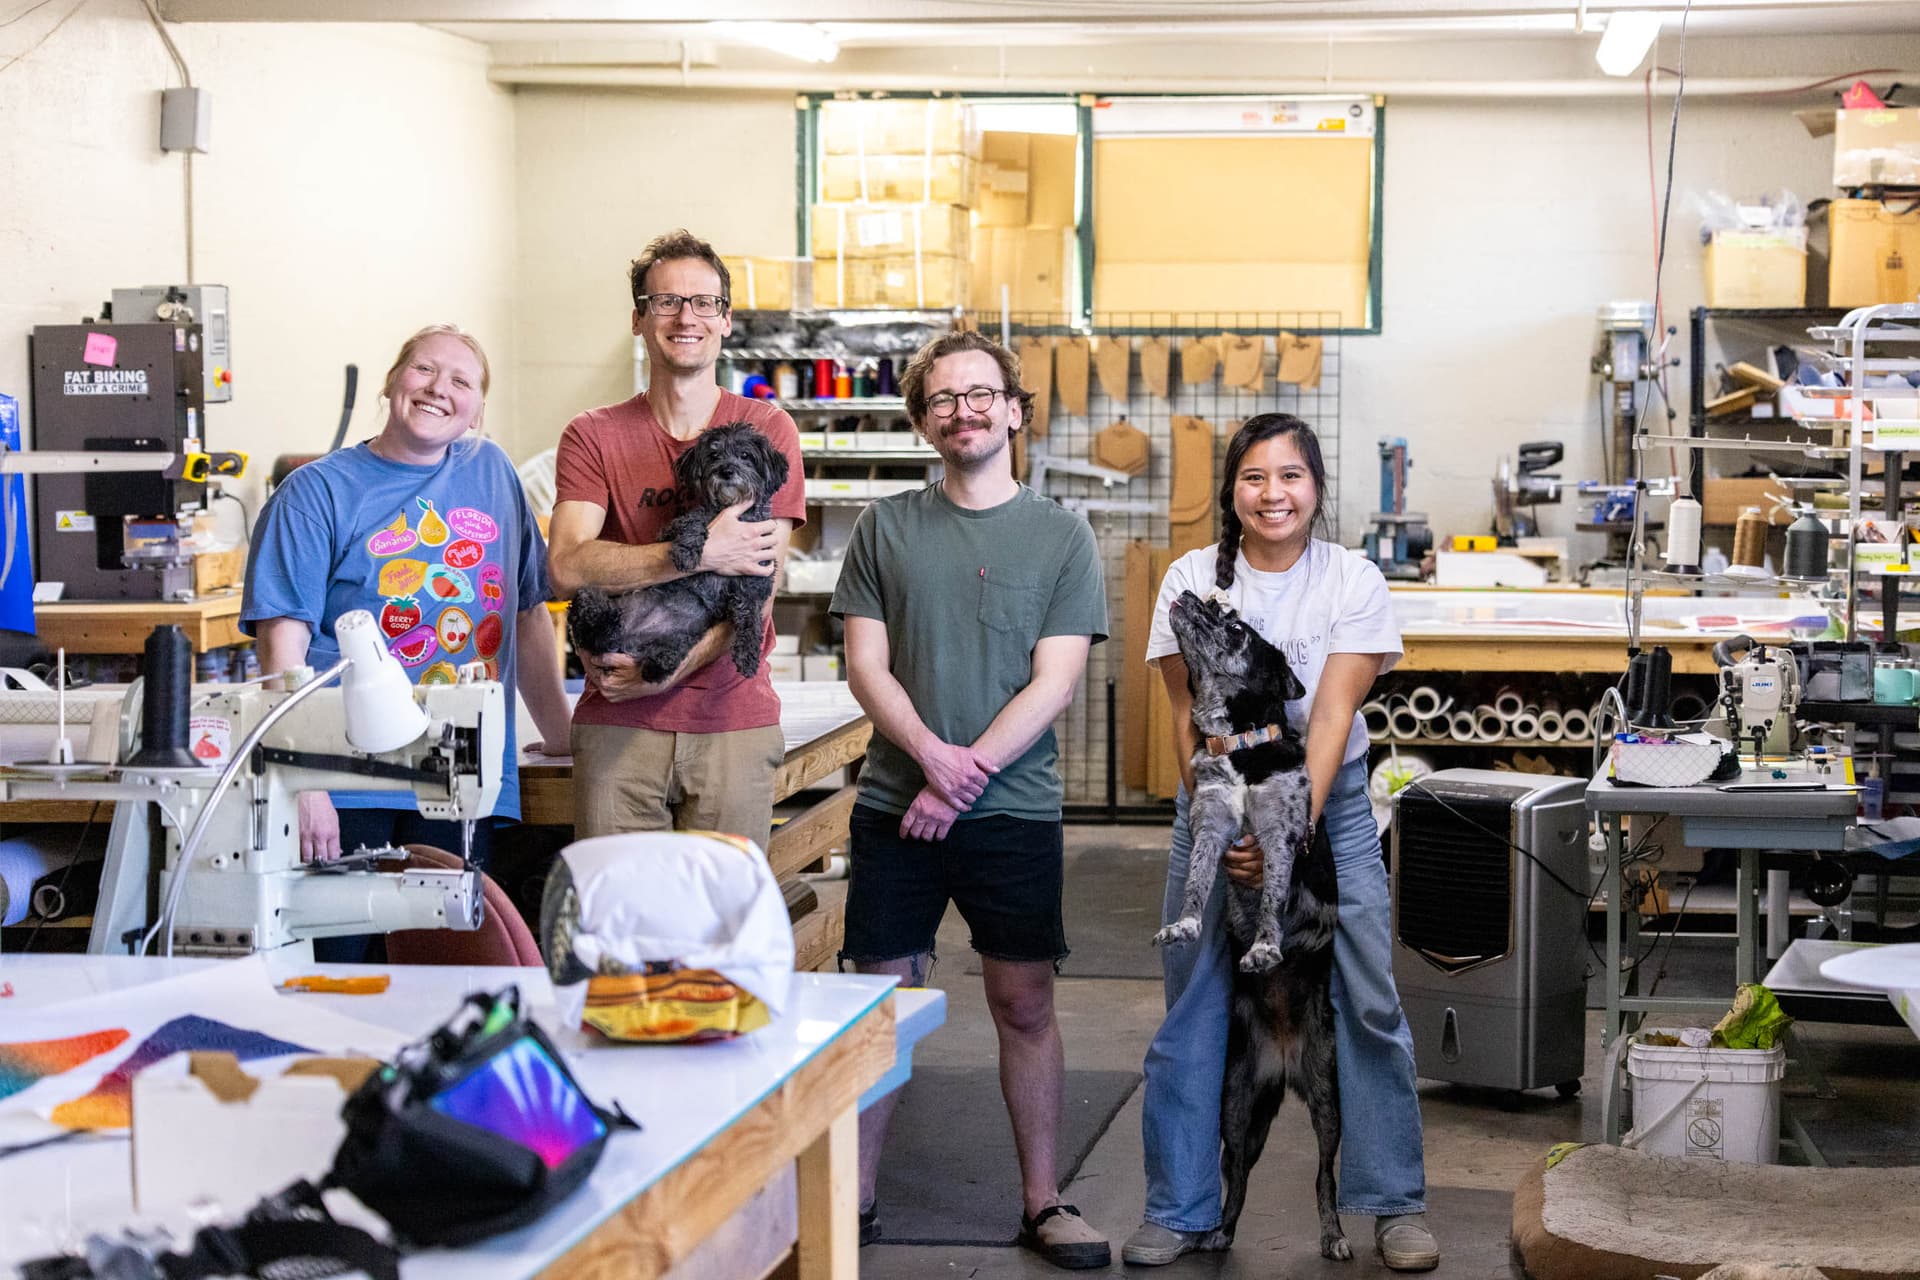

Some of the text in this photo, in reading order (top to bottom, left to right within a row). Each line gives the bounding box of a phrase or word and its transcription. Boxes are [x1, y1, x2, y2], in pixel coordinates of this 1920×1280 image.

[64, 370, 146, 383] FAT BIKING
[65, 384, 143, 393] IS NOT A CRIME
[455, 511, 492, 528] FLORIDA
[374, 535, 412, 551] Bananas
[448, 544, 479, 566] Juicy
[388, 615, 414, 623] BERRY
[390, 622, 411, 630] GOOD
